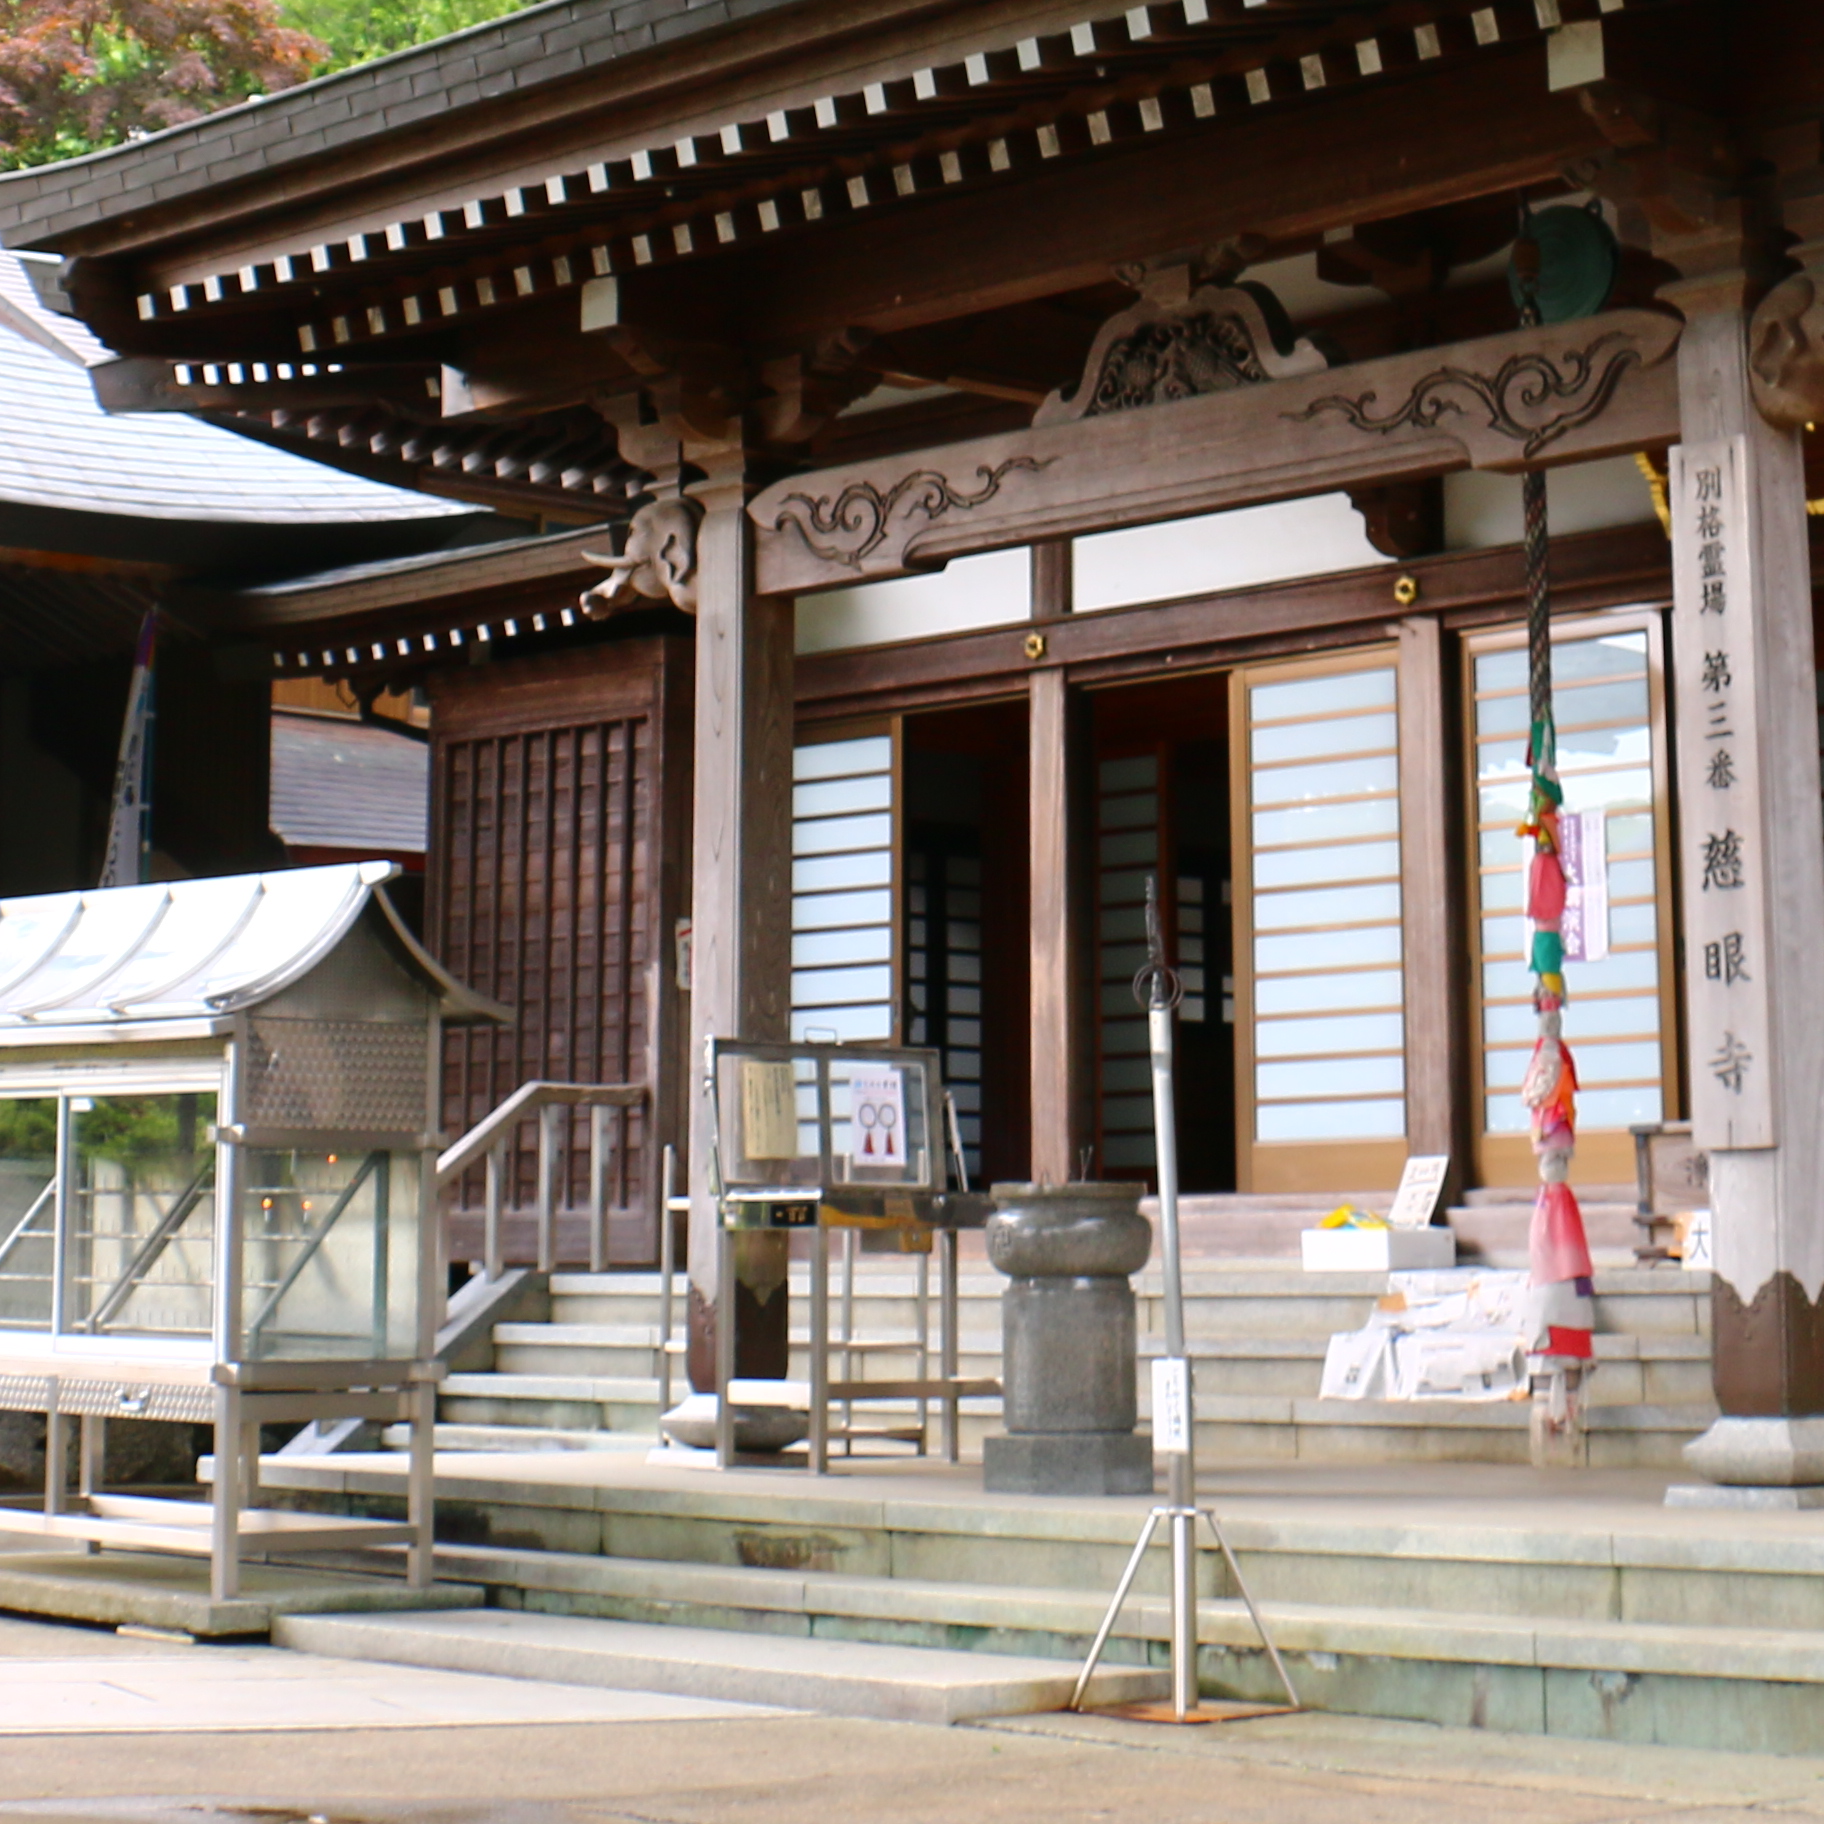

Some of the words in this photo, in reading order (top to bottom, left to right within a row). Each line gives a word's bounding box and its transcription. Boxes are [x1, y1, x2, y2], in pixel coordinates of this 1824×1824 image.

[1694, 464, 1728, 618] 別格霊場
[1700, 651, 1737, 792] 第三番
[1699, 827, 1755, 1097] 慈眼寺
